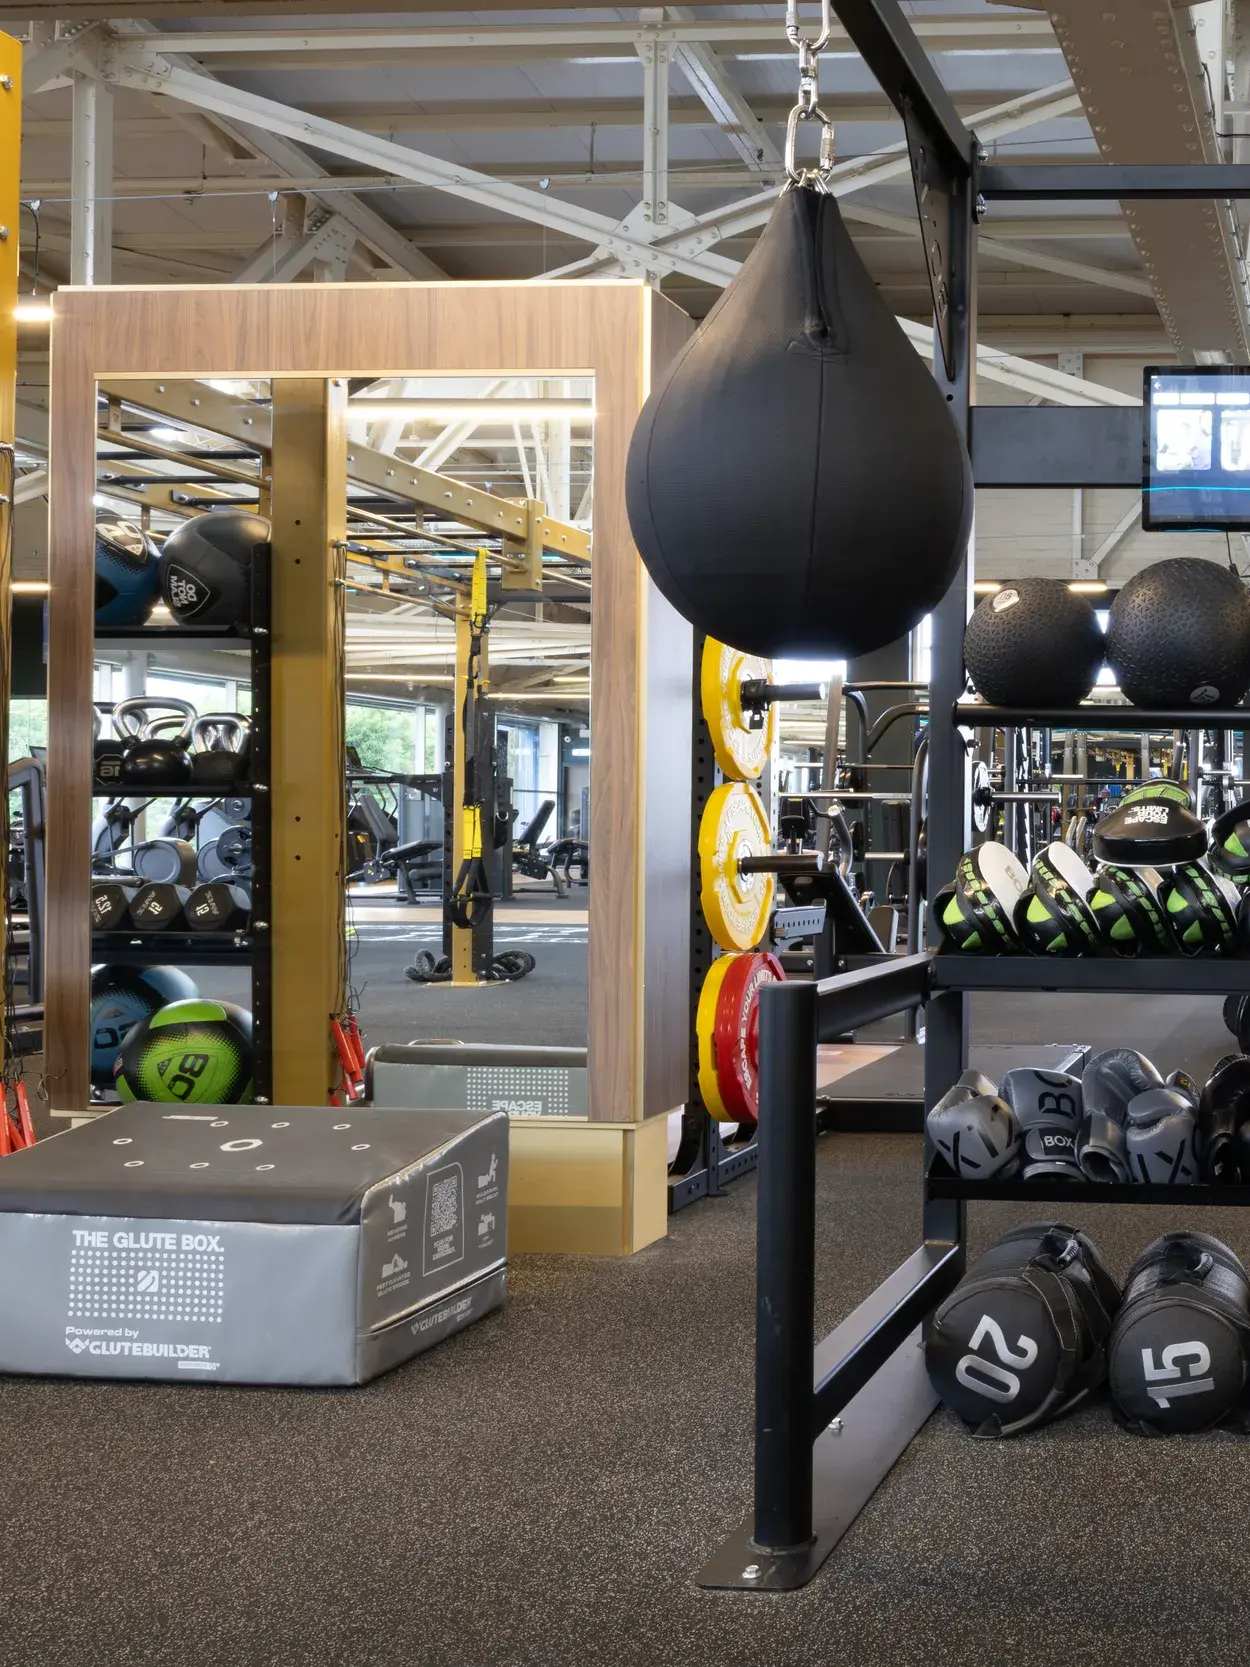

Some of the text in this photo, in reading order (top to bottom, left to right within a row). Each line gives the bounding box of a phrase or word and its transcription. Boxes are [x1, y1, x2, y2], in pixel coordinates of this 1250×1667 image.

[1004, 865, 1023, 893] BO
[741, 985, 755, 1022] YOUR
[72, 1229, 224, 1252] THE GLUTE BOX.
[65, 1326, 139, 1339] Powered by
[955, 1313, 1039, 1404] 20
[1141, 1340, 1215, 1409] 15
